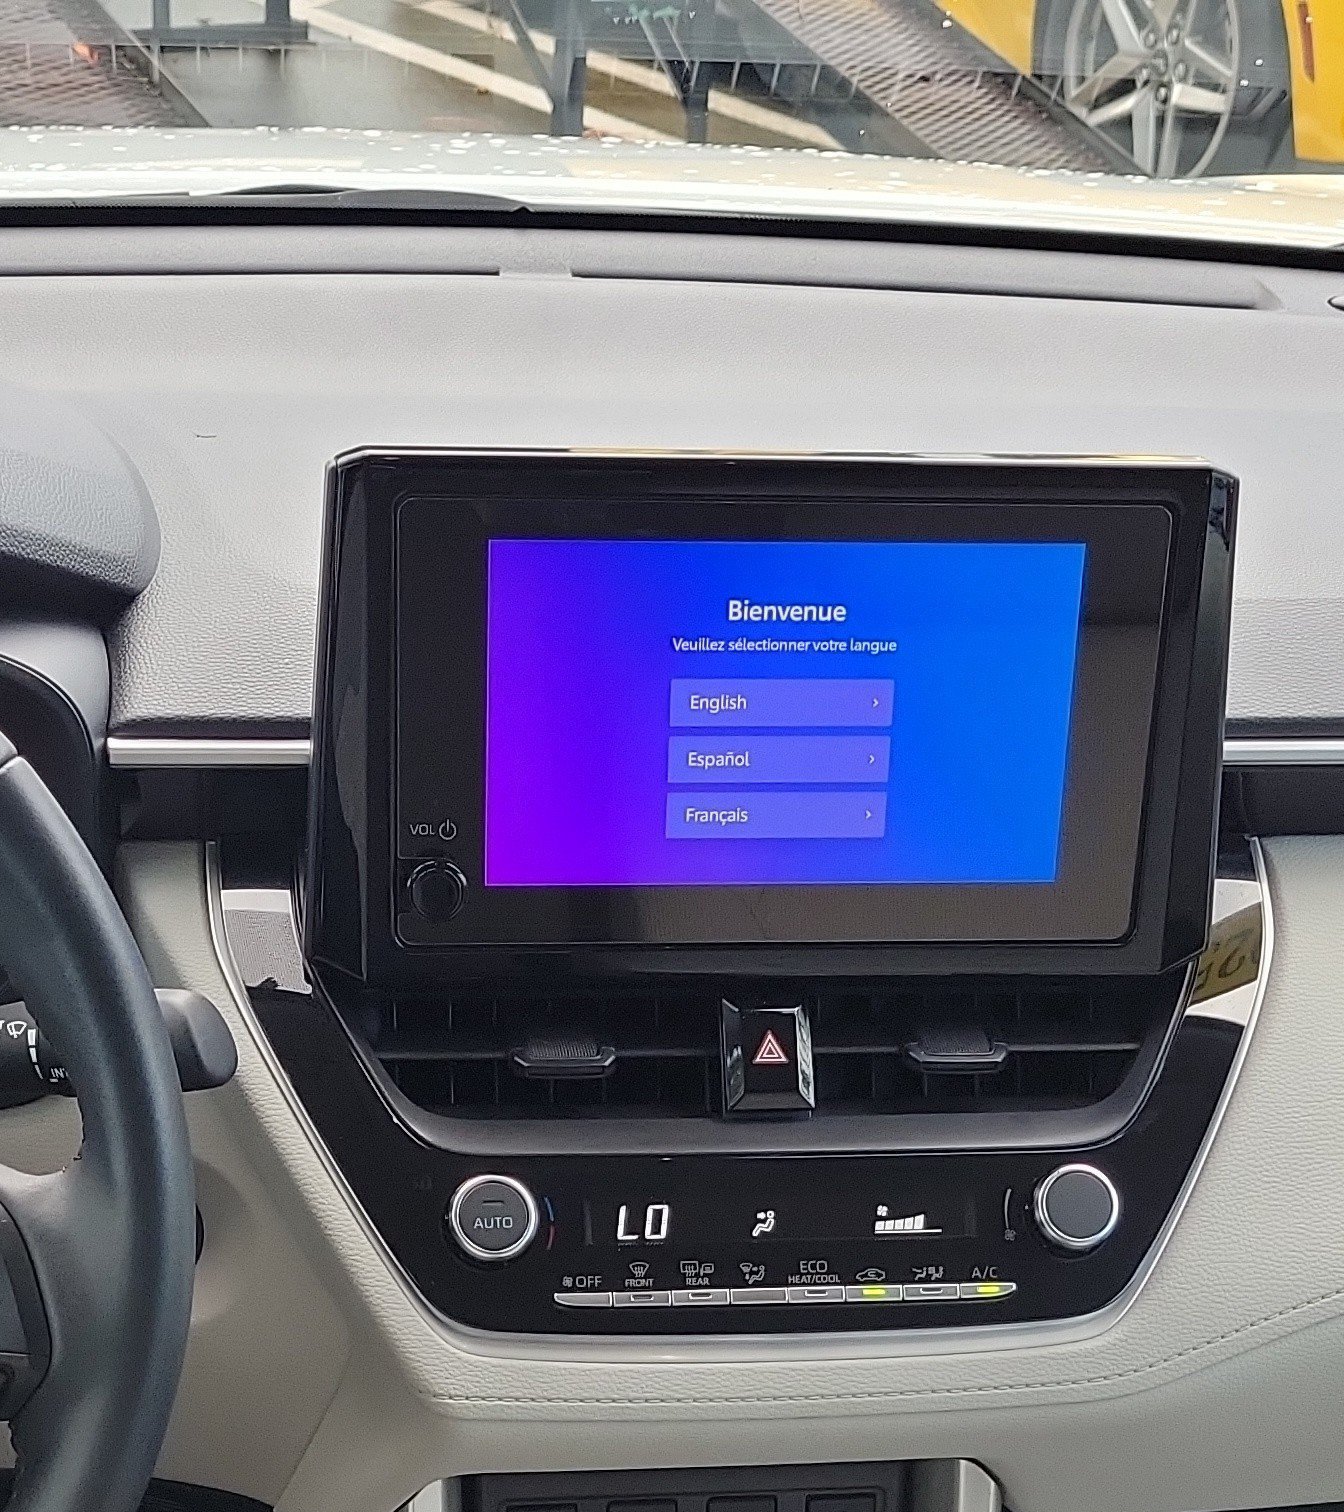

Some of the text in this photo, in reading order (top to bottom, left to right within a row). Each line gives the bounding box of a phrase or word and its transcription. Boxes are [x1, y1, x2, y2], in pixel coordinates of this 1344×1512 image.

[728, 600, 847, 622] Bienvenue
[672, 637, 897, 655] Veuillez sélectionner votre langue
[690, 694, 748, 714] English
[688, 750, 750, 770] Español
[685, 807, 749, 827] Français
[409, 824, 435, 835] VOL
[473, 1216, 513, 1230] AUTO
[617, 1204, 669, 1240] LO
[799, 1260, 828, 1274] ECO
[971, 1266, 998, 1280] A/C
[575, 1275, 602, 1288] OFF
[624, 1277, 654, 1287] FRONT
[686, 1276, 710, 1286] REAR
[788, 1274, 841, 1284] HEAT/COOL
